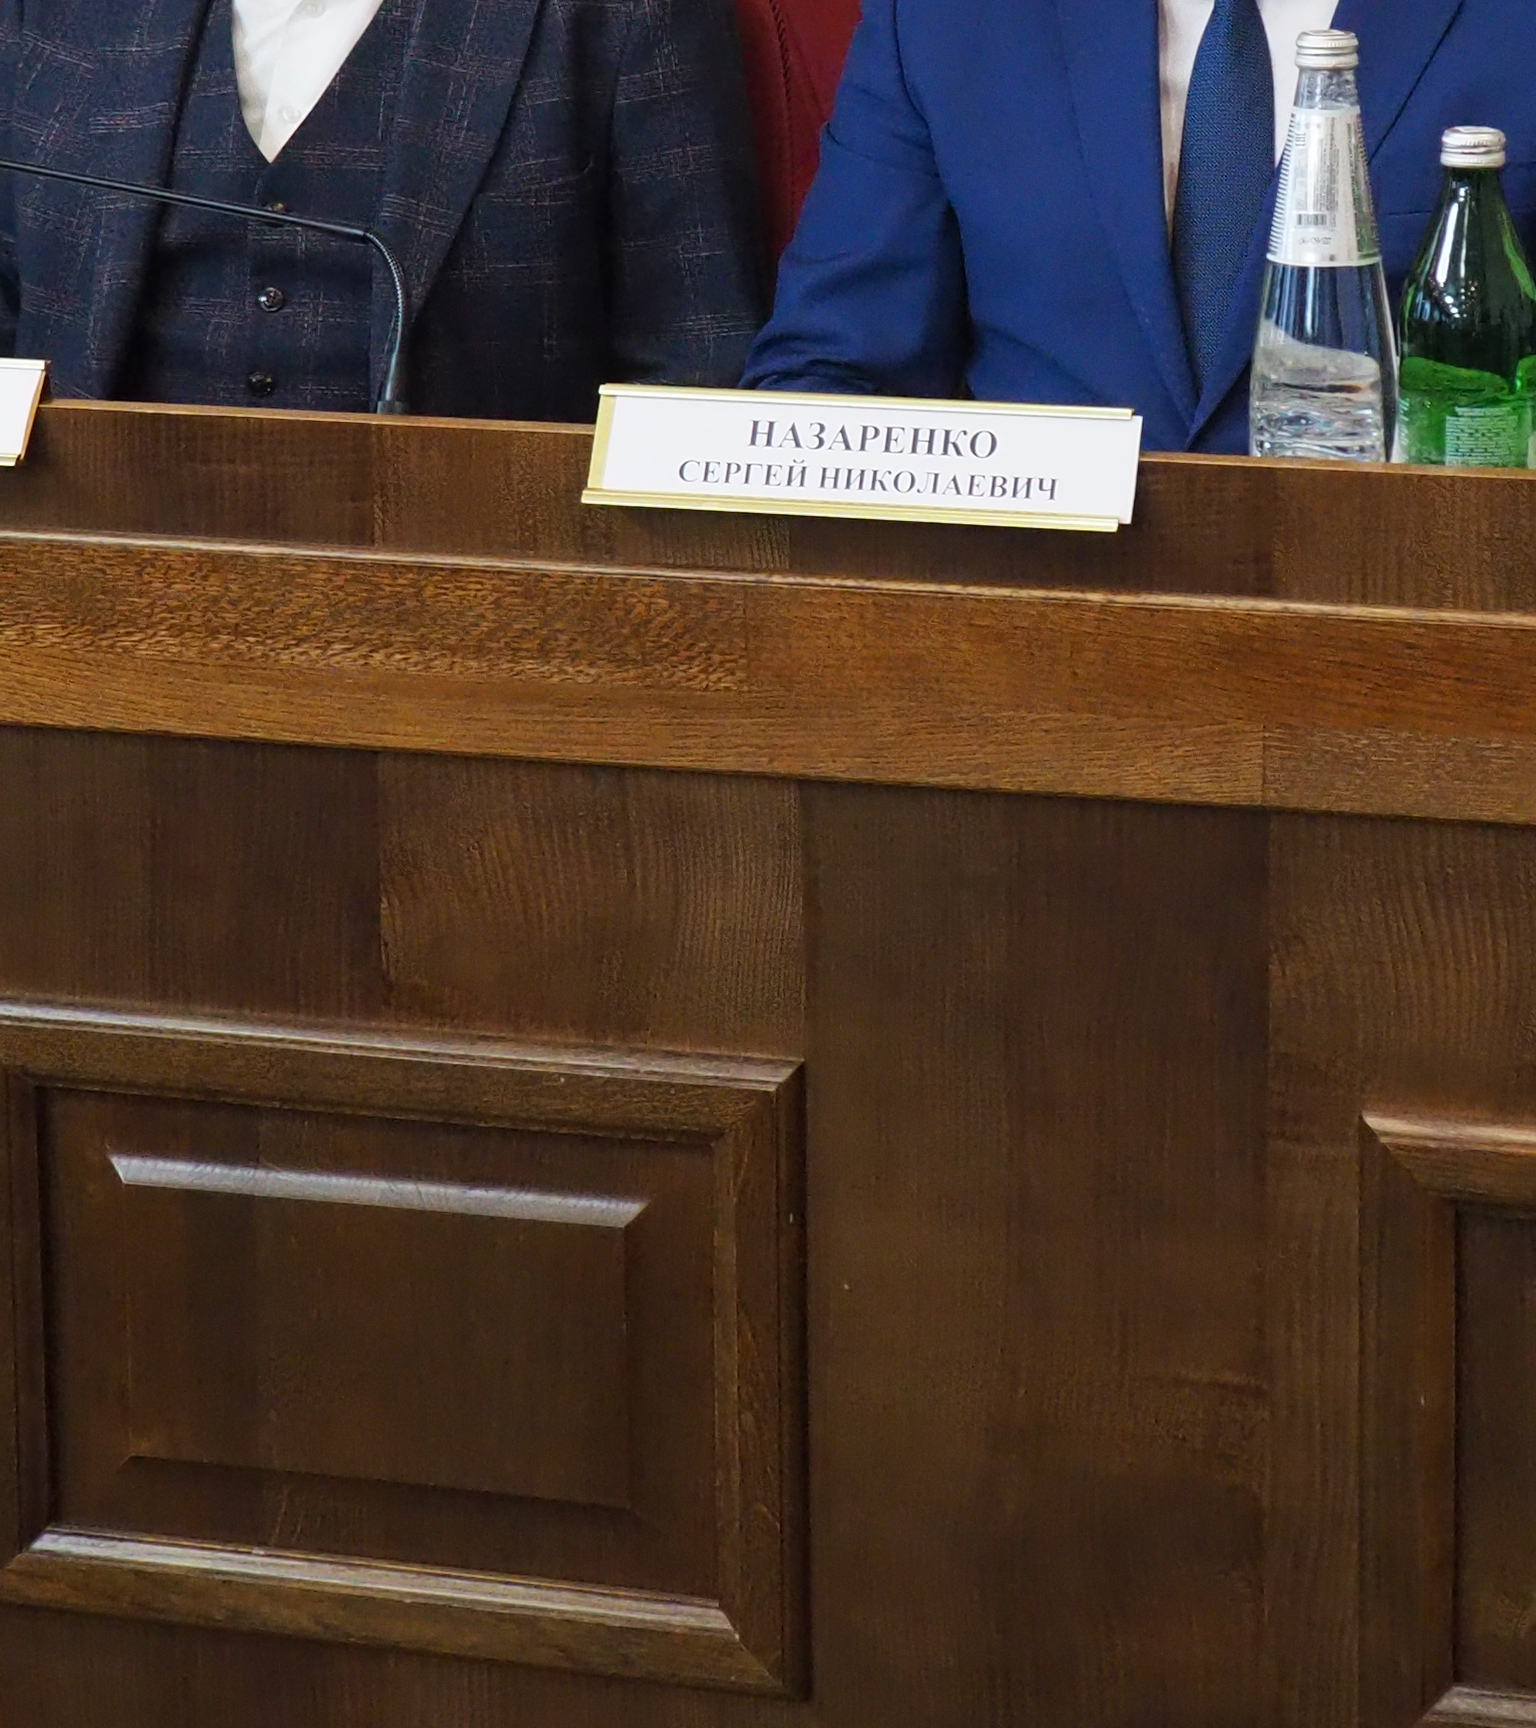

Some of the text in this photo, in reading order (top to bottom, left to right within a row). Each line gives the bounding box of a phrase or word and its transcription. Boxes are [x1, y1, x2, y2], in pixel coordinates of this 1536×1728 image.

[748, 418, 998, 459] НАЗАРЕНКО
[678, 458, 1059, 501] СЕРГЕЙ НИКОЛАЕВИЧ
